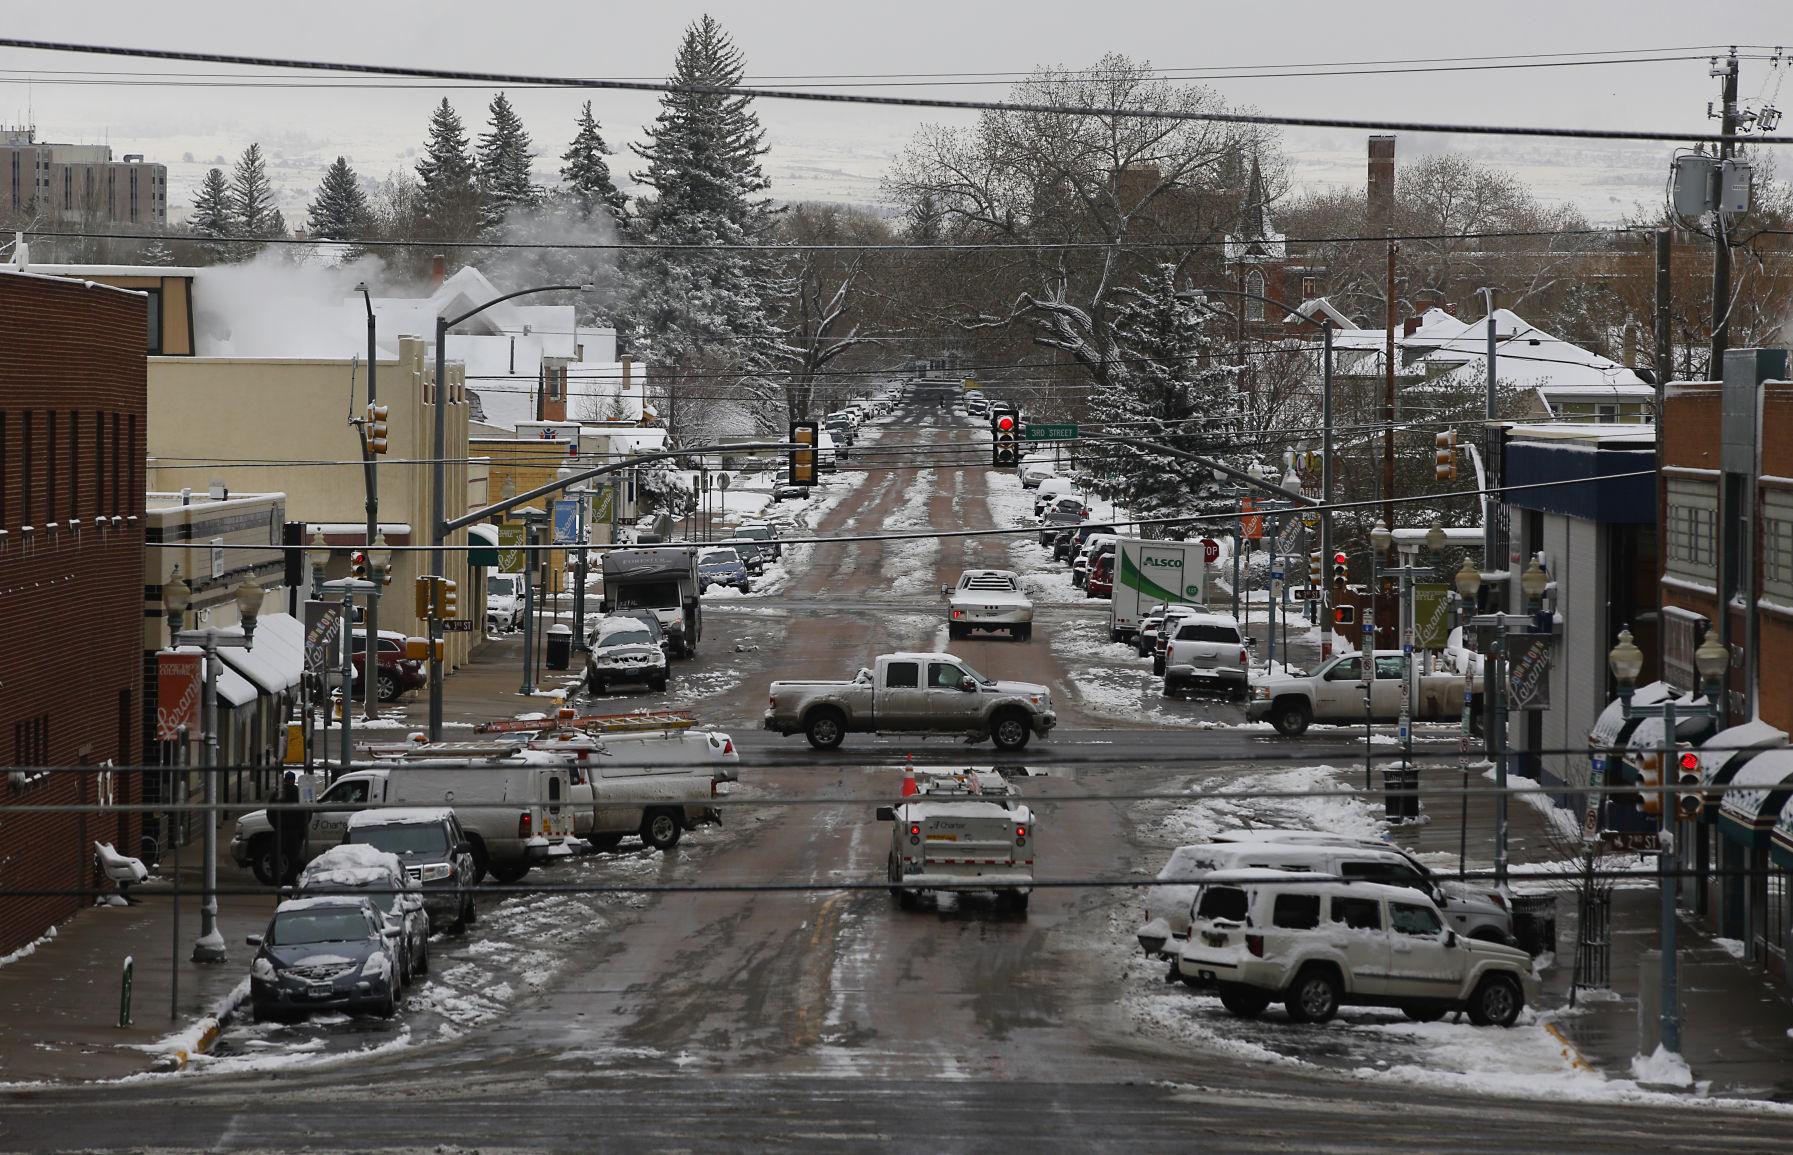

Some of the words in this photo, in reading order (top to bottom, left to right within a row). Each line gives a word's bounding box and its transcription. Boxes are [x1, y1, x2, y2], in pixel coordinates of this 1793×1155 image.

[1031, 429, 1046, 438] 3RD
[1048, 428, 1073, 438] STREET
[1143, 556, 1183, 568] ALSCO
[463, 621, 471, 630] ST
[1509, 648, 1550, 709] Laramie
[1645, 835, 1656, 849] ST
